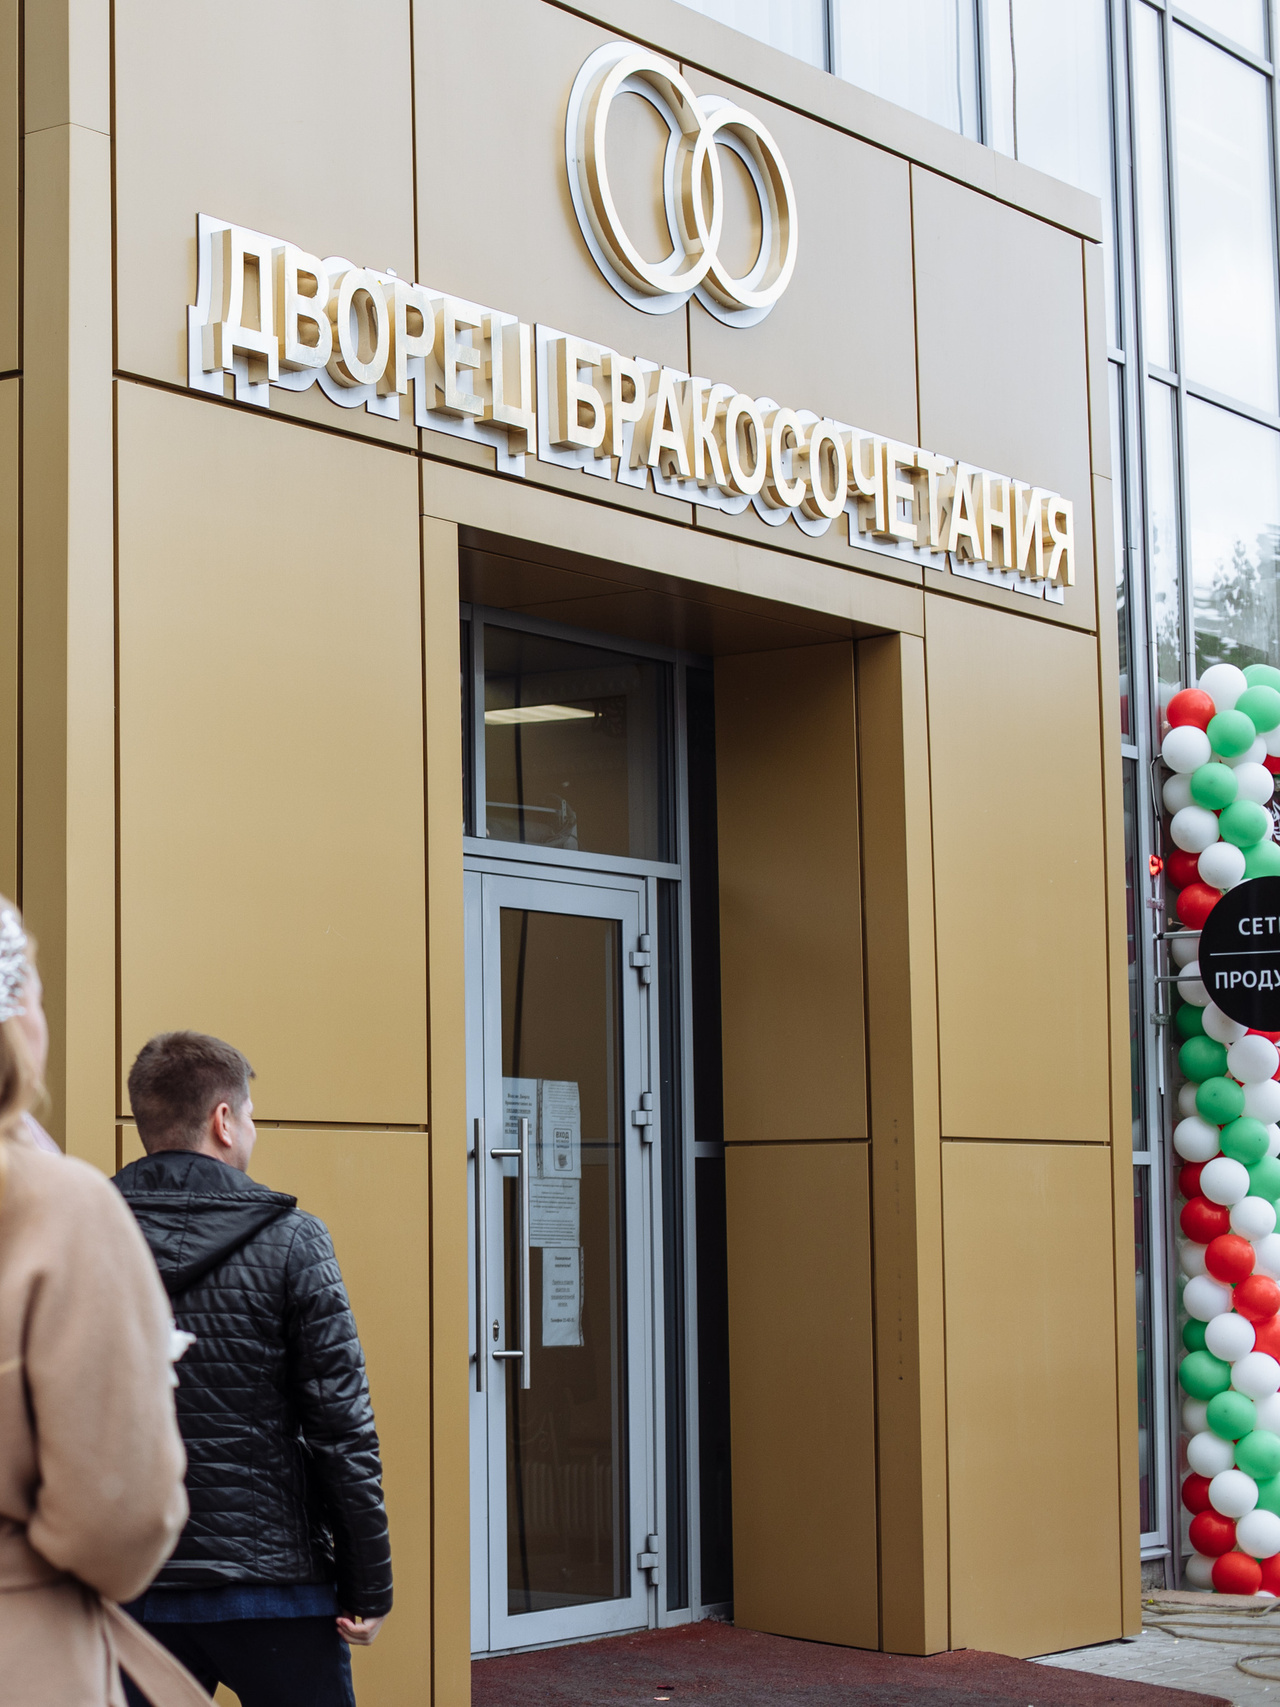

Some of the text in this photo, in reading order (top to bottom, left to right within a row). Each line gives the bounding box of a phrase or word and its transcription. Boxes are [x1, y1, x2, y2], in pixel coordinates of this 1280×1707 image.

[200, 226, 1076, 588] ДВОРЕЦ БРАКОСОЧЕТАНИЯ
[1238, 916, 1280, 935] СЕТ
